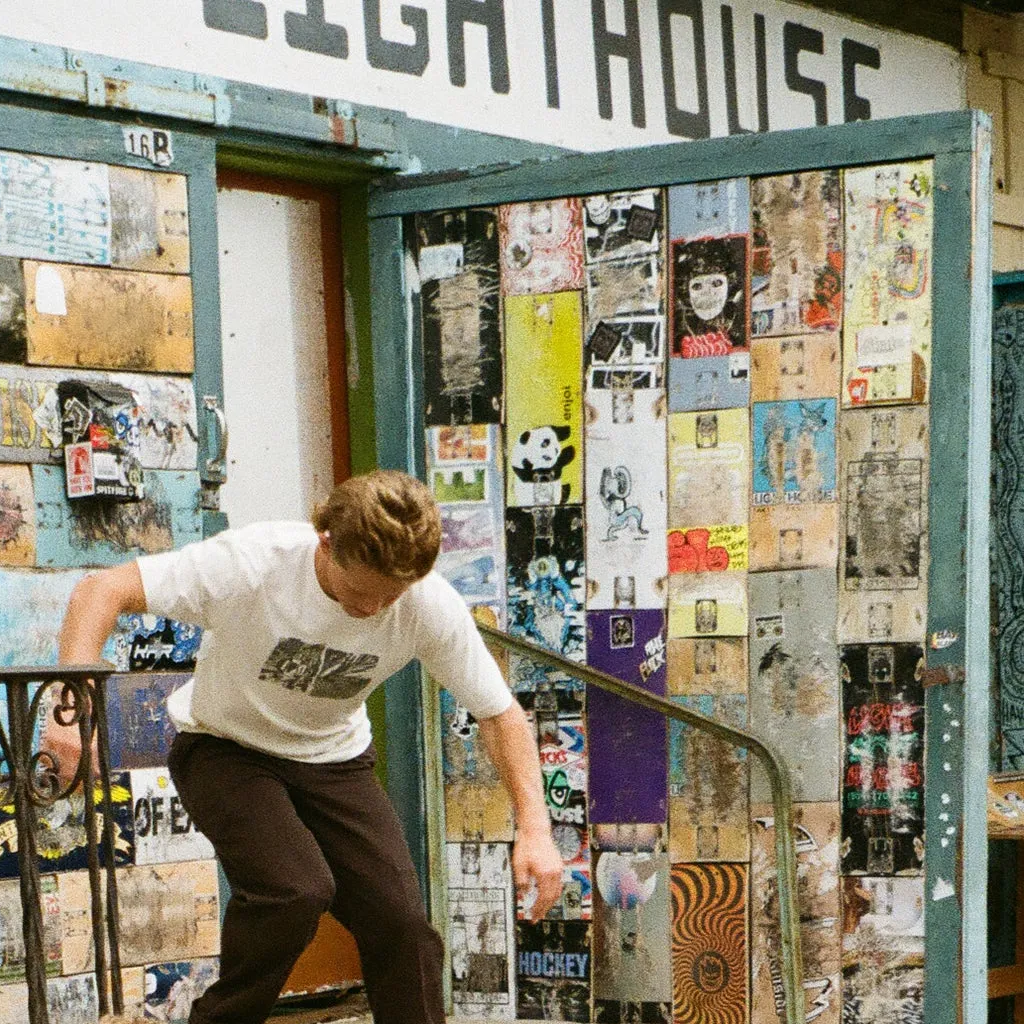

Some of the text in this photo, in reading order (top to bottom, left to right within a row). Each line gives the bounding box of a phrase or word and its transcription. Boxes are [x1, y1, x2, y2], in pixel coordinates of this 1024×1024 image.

[203, 0, 881, 139] GHTHOUSE
[562, 384, 574, 421] enjoi
[518, 951, 589, 978] HOCKEY
